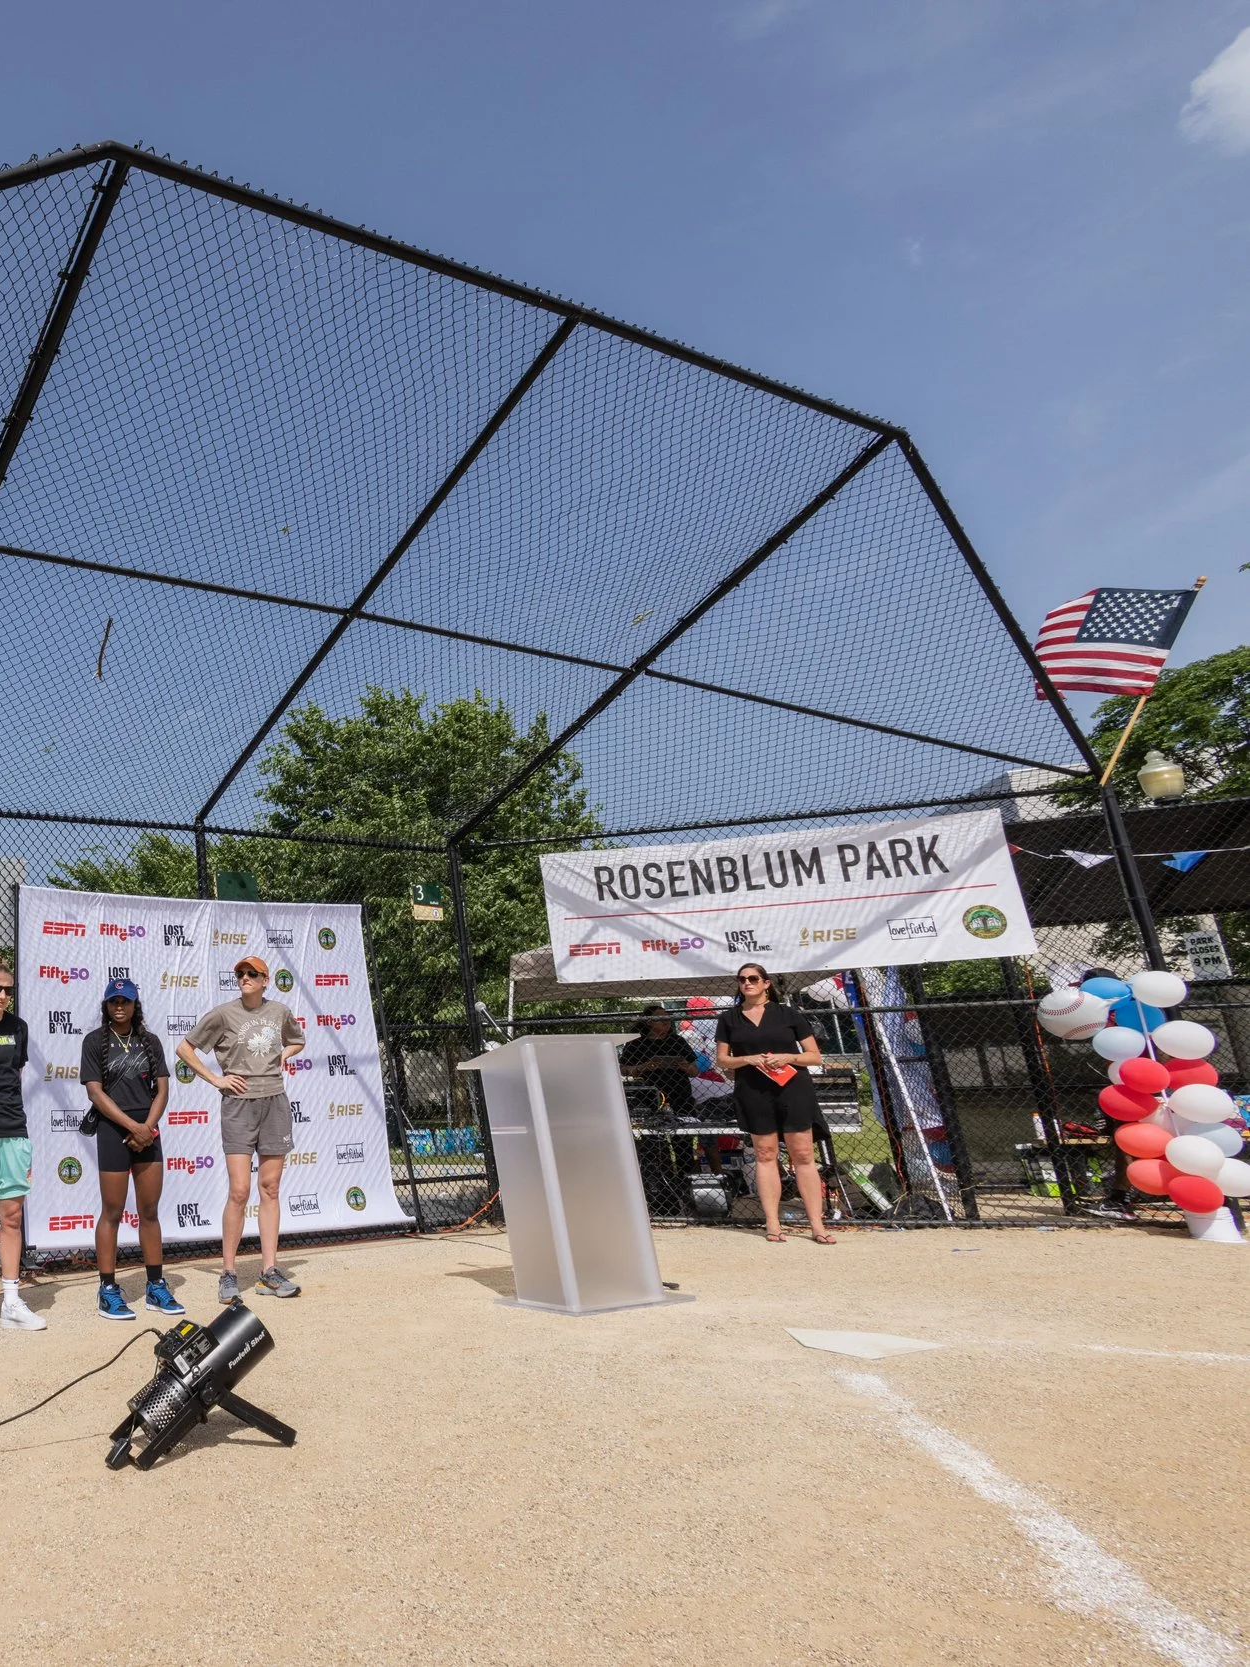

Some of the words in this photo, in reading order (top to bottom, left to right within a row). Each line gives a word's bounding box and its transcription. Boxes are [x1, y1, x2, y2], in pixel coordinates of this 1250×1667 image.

[593, 846, 826, 901] ROSENBLUM
[839, 834, 950, 881] PARK
[416, 885, 424, 900] 3
[43, 921, 86, 936] ESPN
[100, 923, 146, 941] Fifty50
[164, 925, 184, 935] LOST
[220, 933, 247, 945] RISE
[725, 930, 754, 942] LOST
[813, 928, 857, 943] RISE
[1190, 937, 1214, 945] PARK
[569, 942, 621, 957] ESPN
[641, 937, 704, 955] Fifty50
[728, 941, 759, 953] BOYZ
[1190, 945, 1220, 954] CLOSES
[1194, 958, 1201, 966] 9
[1203, 956, 1222, 965] PM
[40, 966, 89, 984] Fifty50
[108, 966, 130, 979] LOST
[170, 976, 199, 987] RISE
[315, 974, 348, 986] ESPN
[49, 1011, 71, 1022] LOST
[317, 1014, 356, 1030] Fifty50
[328, 1055, 346, 1066] LOST
[55, 1066, 79, 1079] RIS
[290, 1101, 300, 1112] ST
[337, 1104, 363, 1117] RISE
[168, 1111, 208, 1125] ESPN
[167, 1155, 214, 1175] Fifty50
[290, 1152, 317, 1165] RISE
[177, 1203, 199, 1215] LOST
[49, 1214, 94, 1231] ESPN
